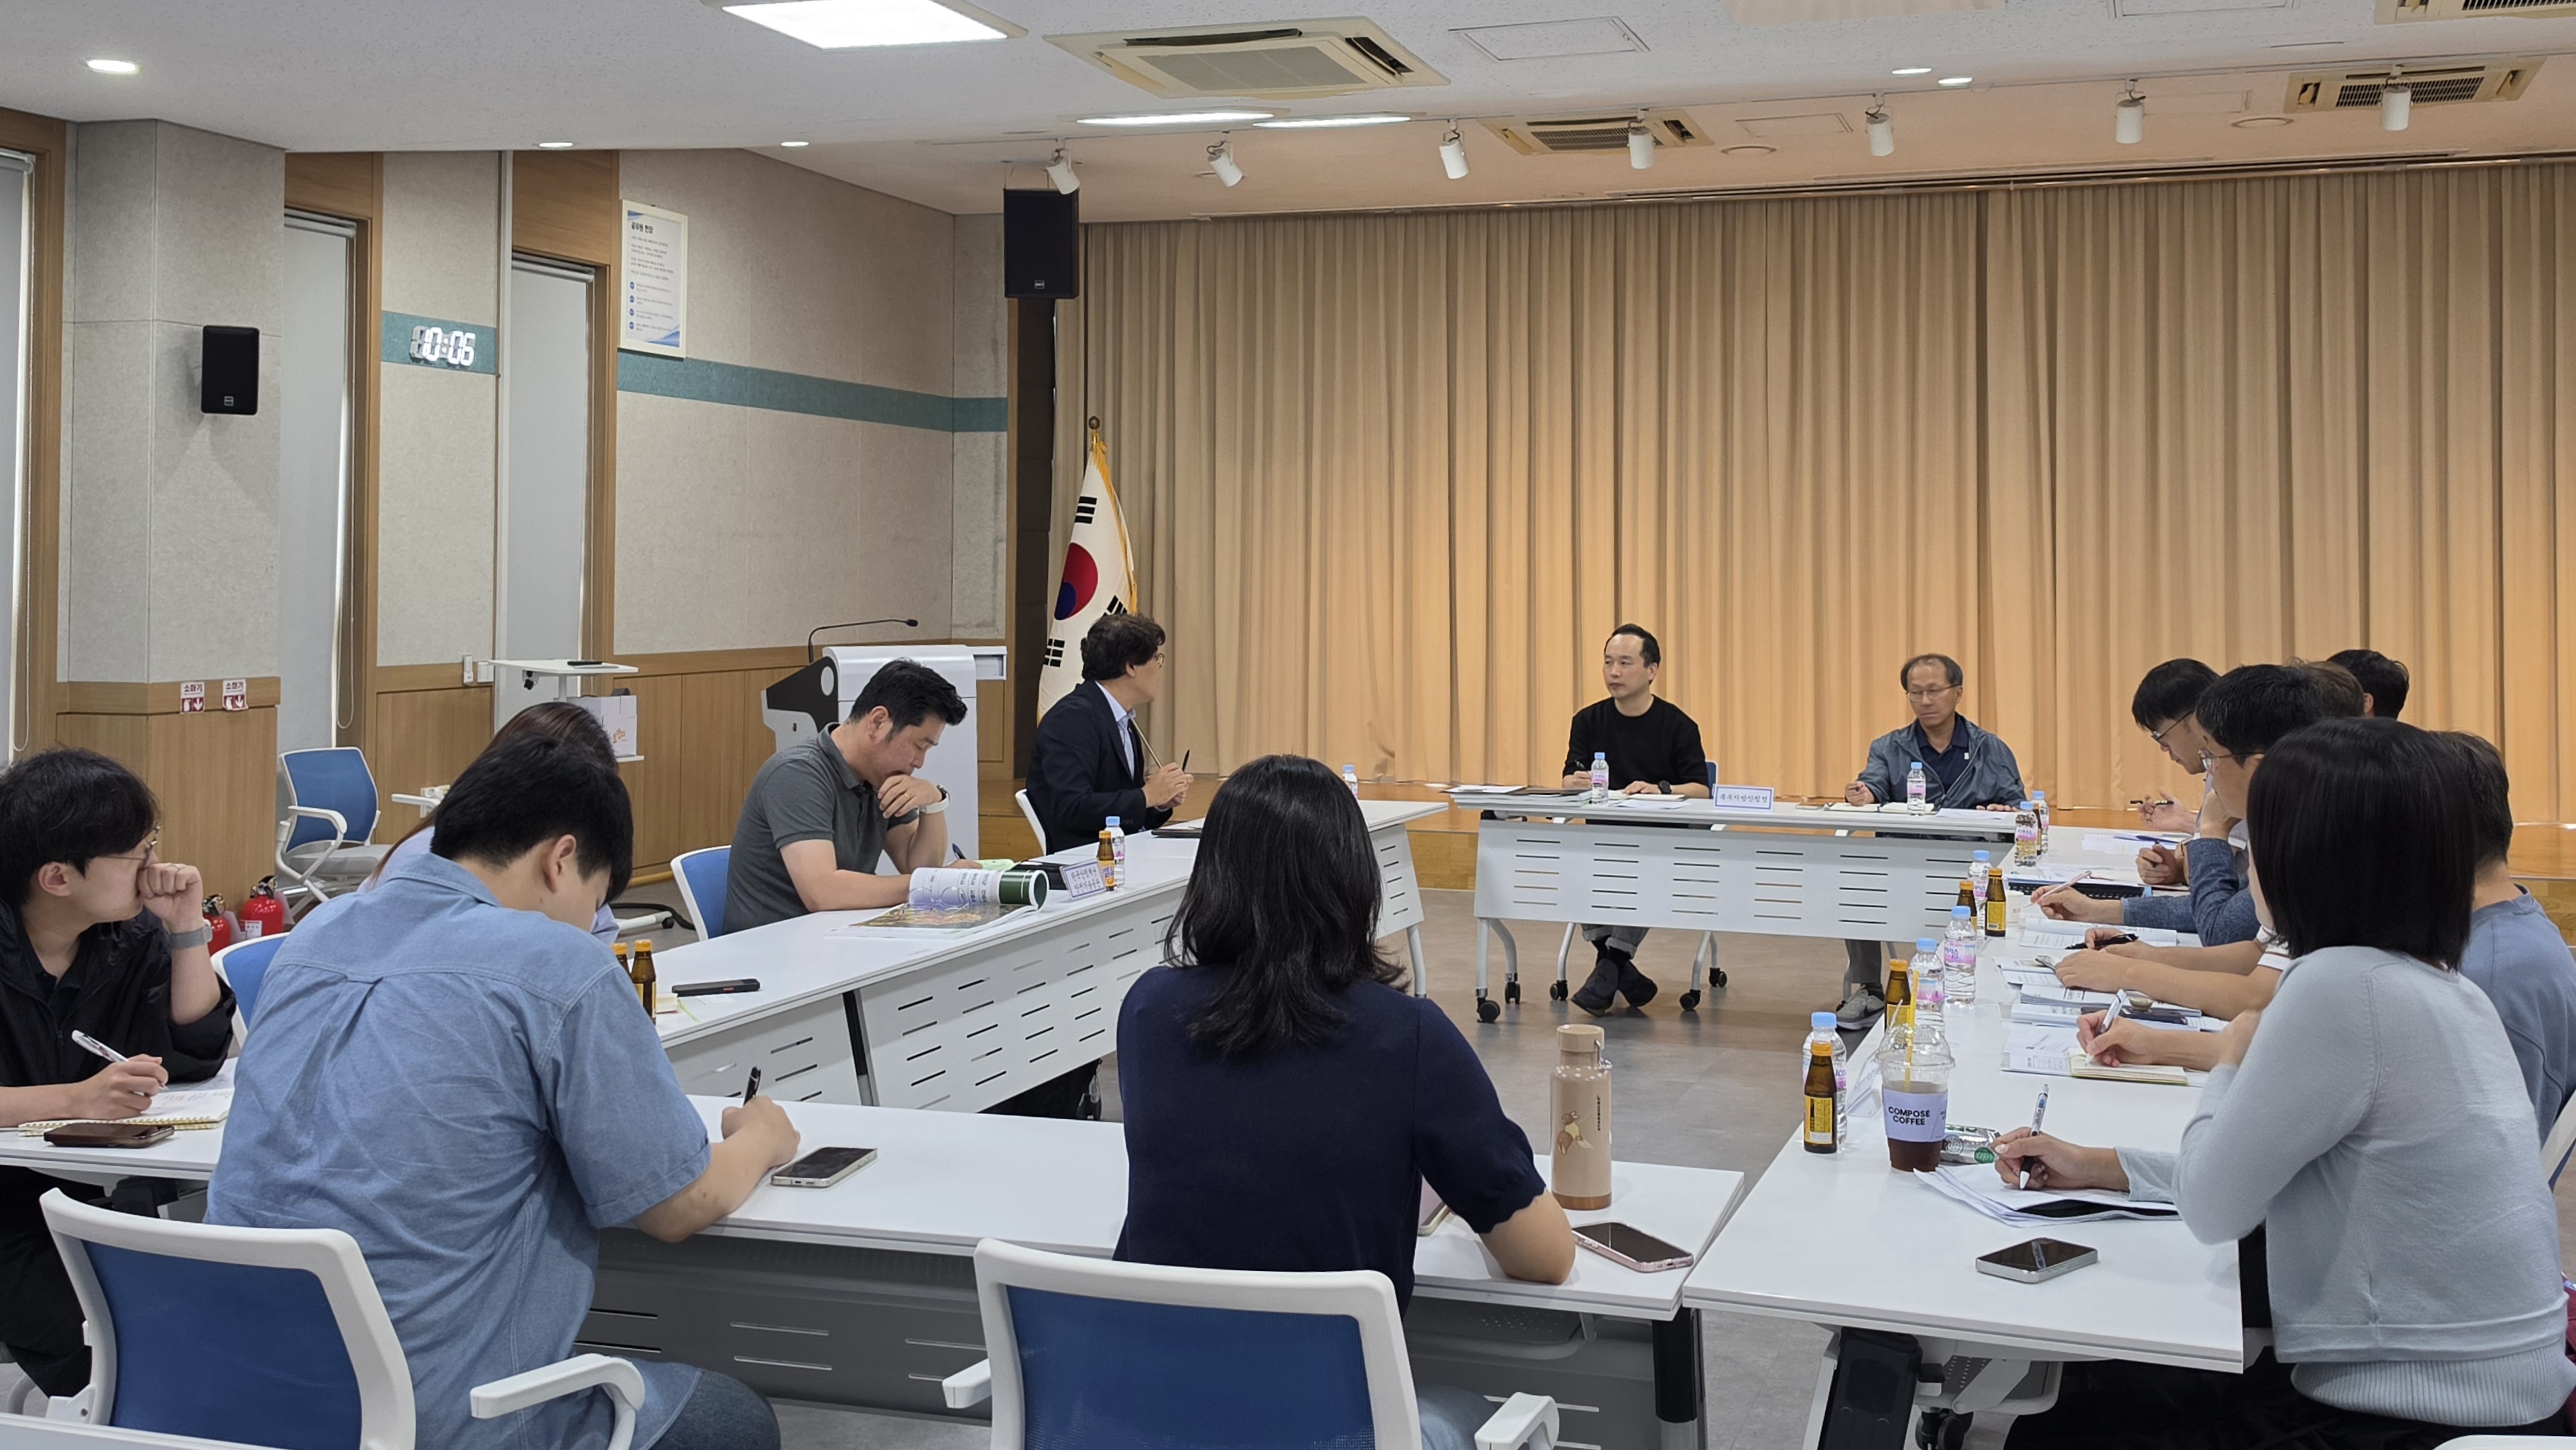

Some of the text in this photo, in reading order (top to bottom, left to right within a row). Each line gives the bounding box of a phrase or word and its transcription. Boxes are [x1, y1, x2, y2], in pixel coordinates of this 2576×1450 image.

[421, 326, 476, 366] 10:06
[184, 683, 203, 692] 소화기
[225, 681, 244, 690] 소화기
[1888, 1106, 1930, 1117] COMPOSE
[1893, 1115, 1926, 1125] COFFEE
